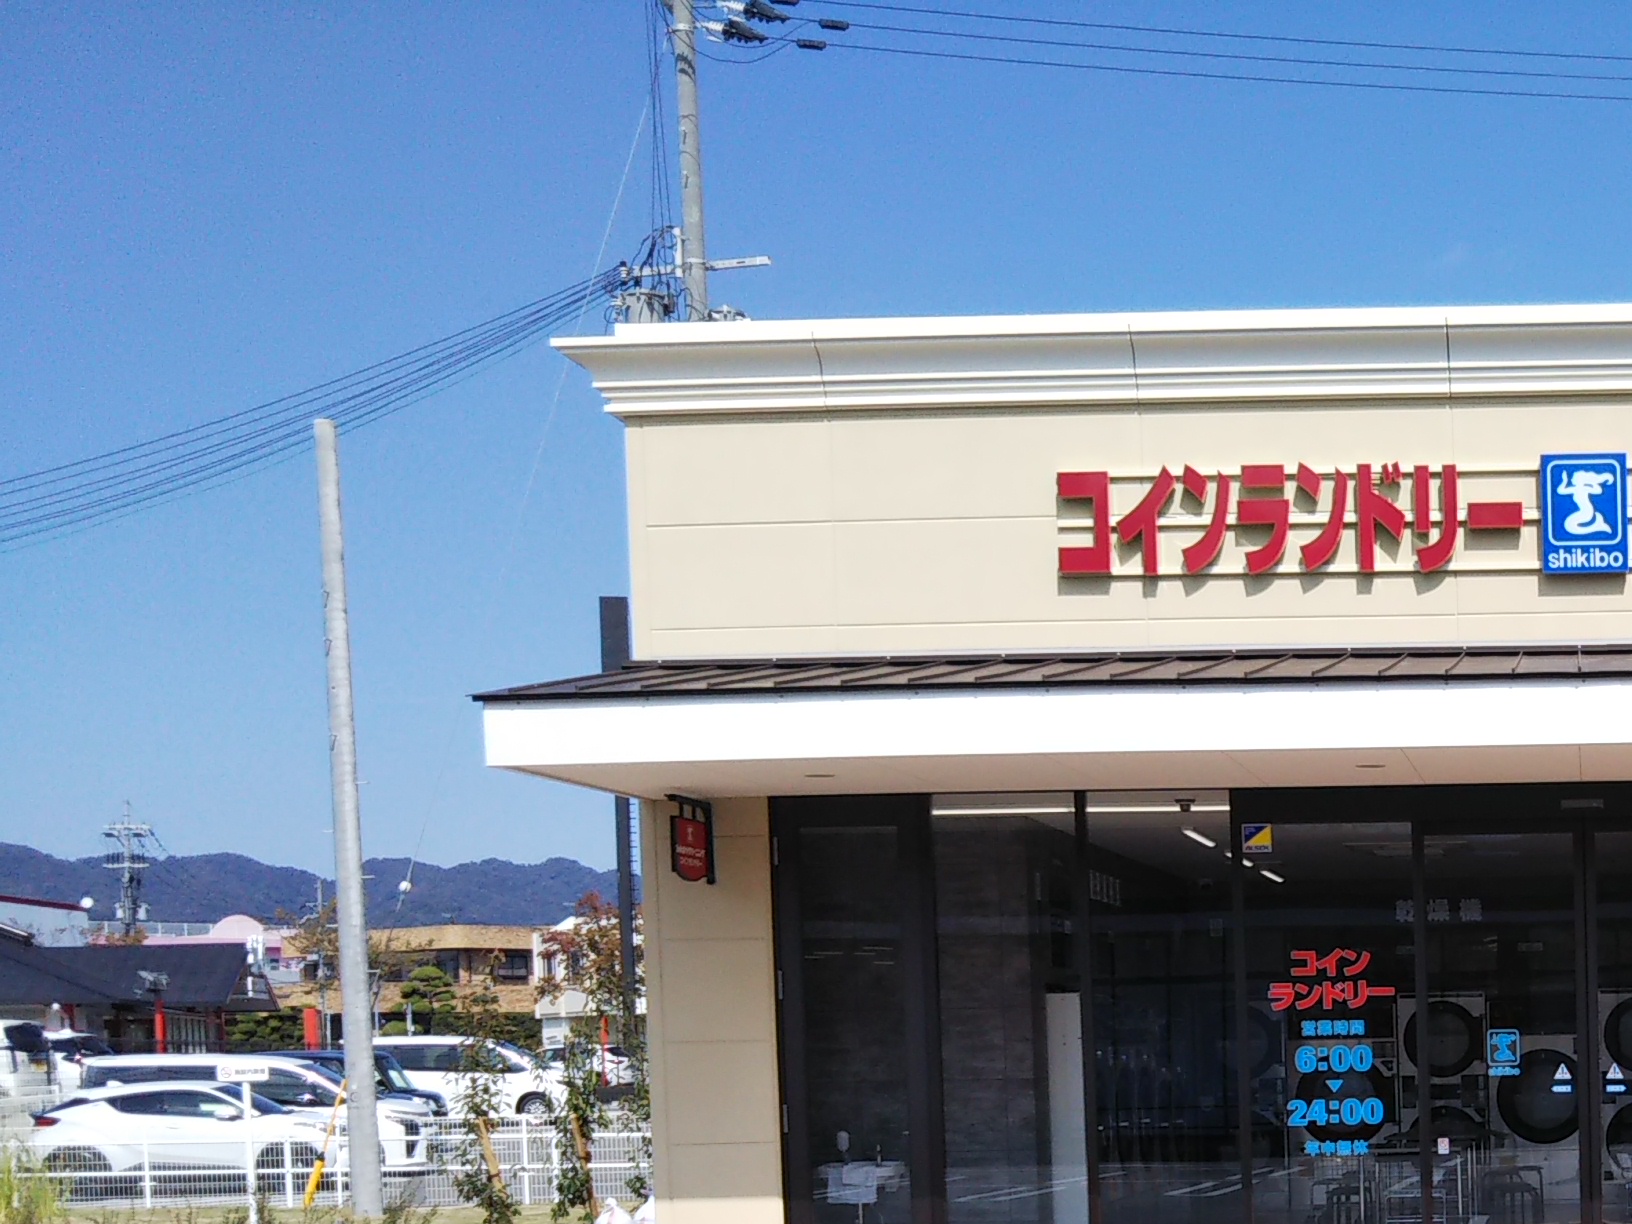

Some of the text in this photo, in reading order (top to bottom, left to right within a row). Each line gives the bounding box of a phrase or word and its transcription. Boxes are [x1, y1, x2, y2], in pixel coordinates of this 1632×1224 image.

[1057, 461, 1523, 575] コインランドリー
[1547, 548, 1624, 568] shikibo
[1290, 948, 1370, 977] コイン
[1268, 980, 1395, 1012] ランドリー
[1301, 1020, 1365, 1037] 営業時間
[1294, 1045, 1373, 1073] 6:00
[1287, 1098, 1384, 1126] 24:00
[1304, 1140, 1369, 1156] 年中無休
